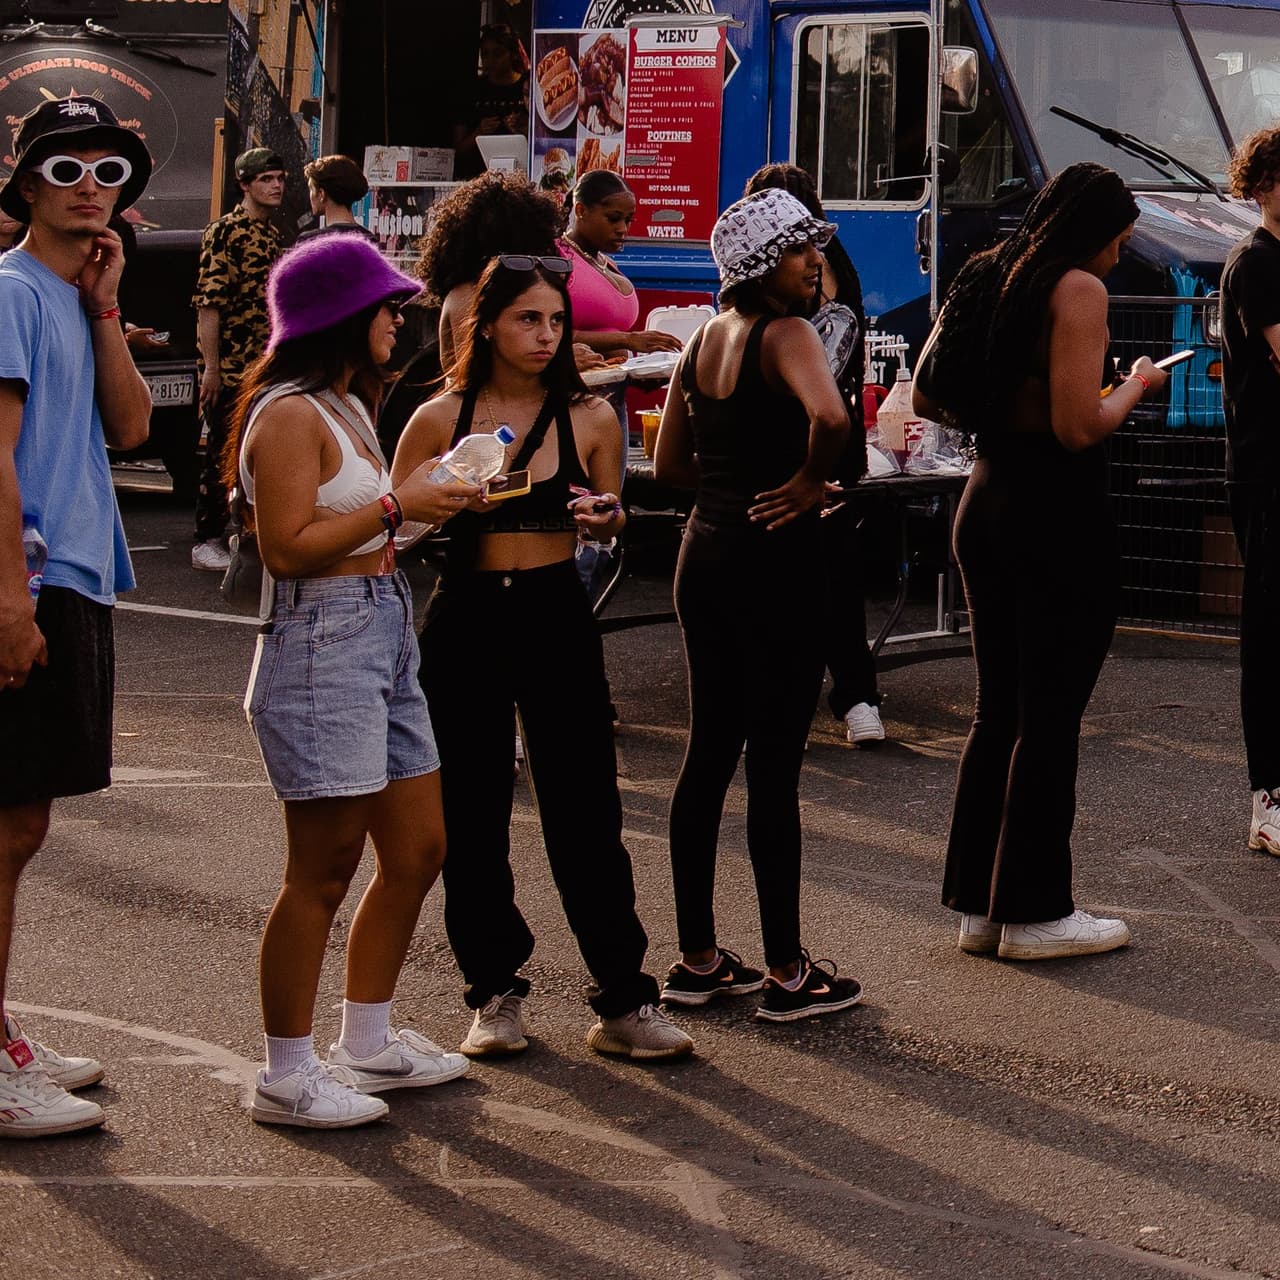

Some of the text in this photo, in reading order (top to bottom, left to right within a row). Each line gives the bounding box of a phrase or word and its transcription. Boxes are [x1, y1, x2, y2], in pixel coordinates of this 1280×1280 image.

[656, 29, 699, 43] MENU
[634, 55, 716, 68] BURGER COMBOS
[9, 58, 72, 81] ULTIMATE
[73, 58, 108, 74] FOOD
[110, 68, 152, 101] TRUCK
[647, 131, 692, 141] POUTINES
[369, 208, 423, 236] Fusion
[647, 226, 685, 238] WATER
[161, 382, 191, 398] 81377
